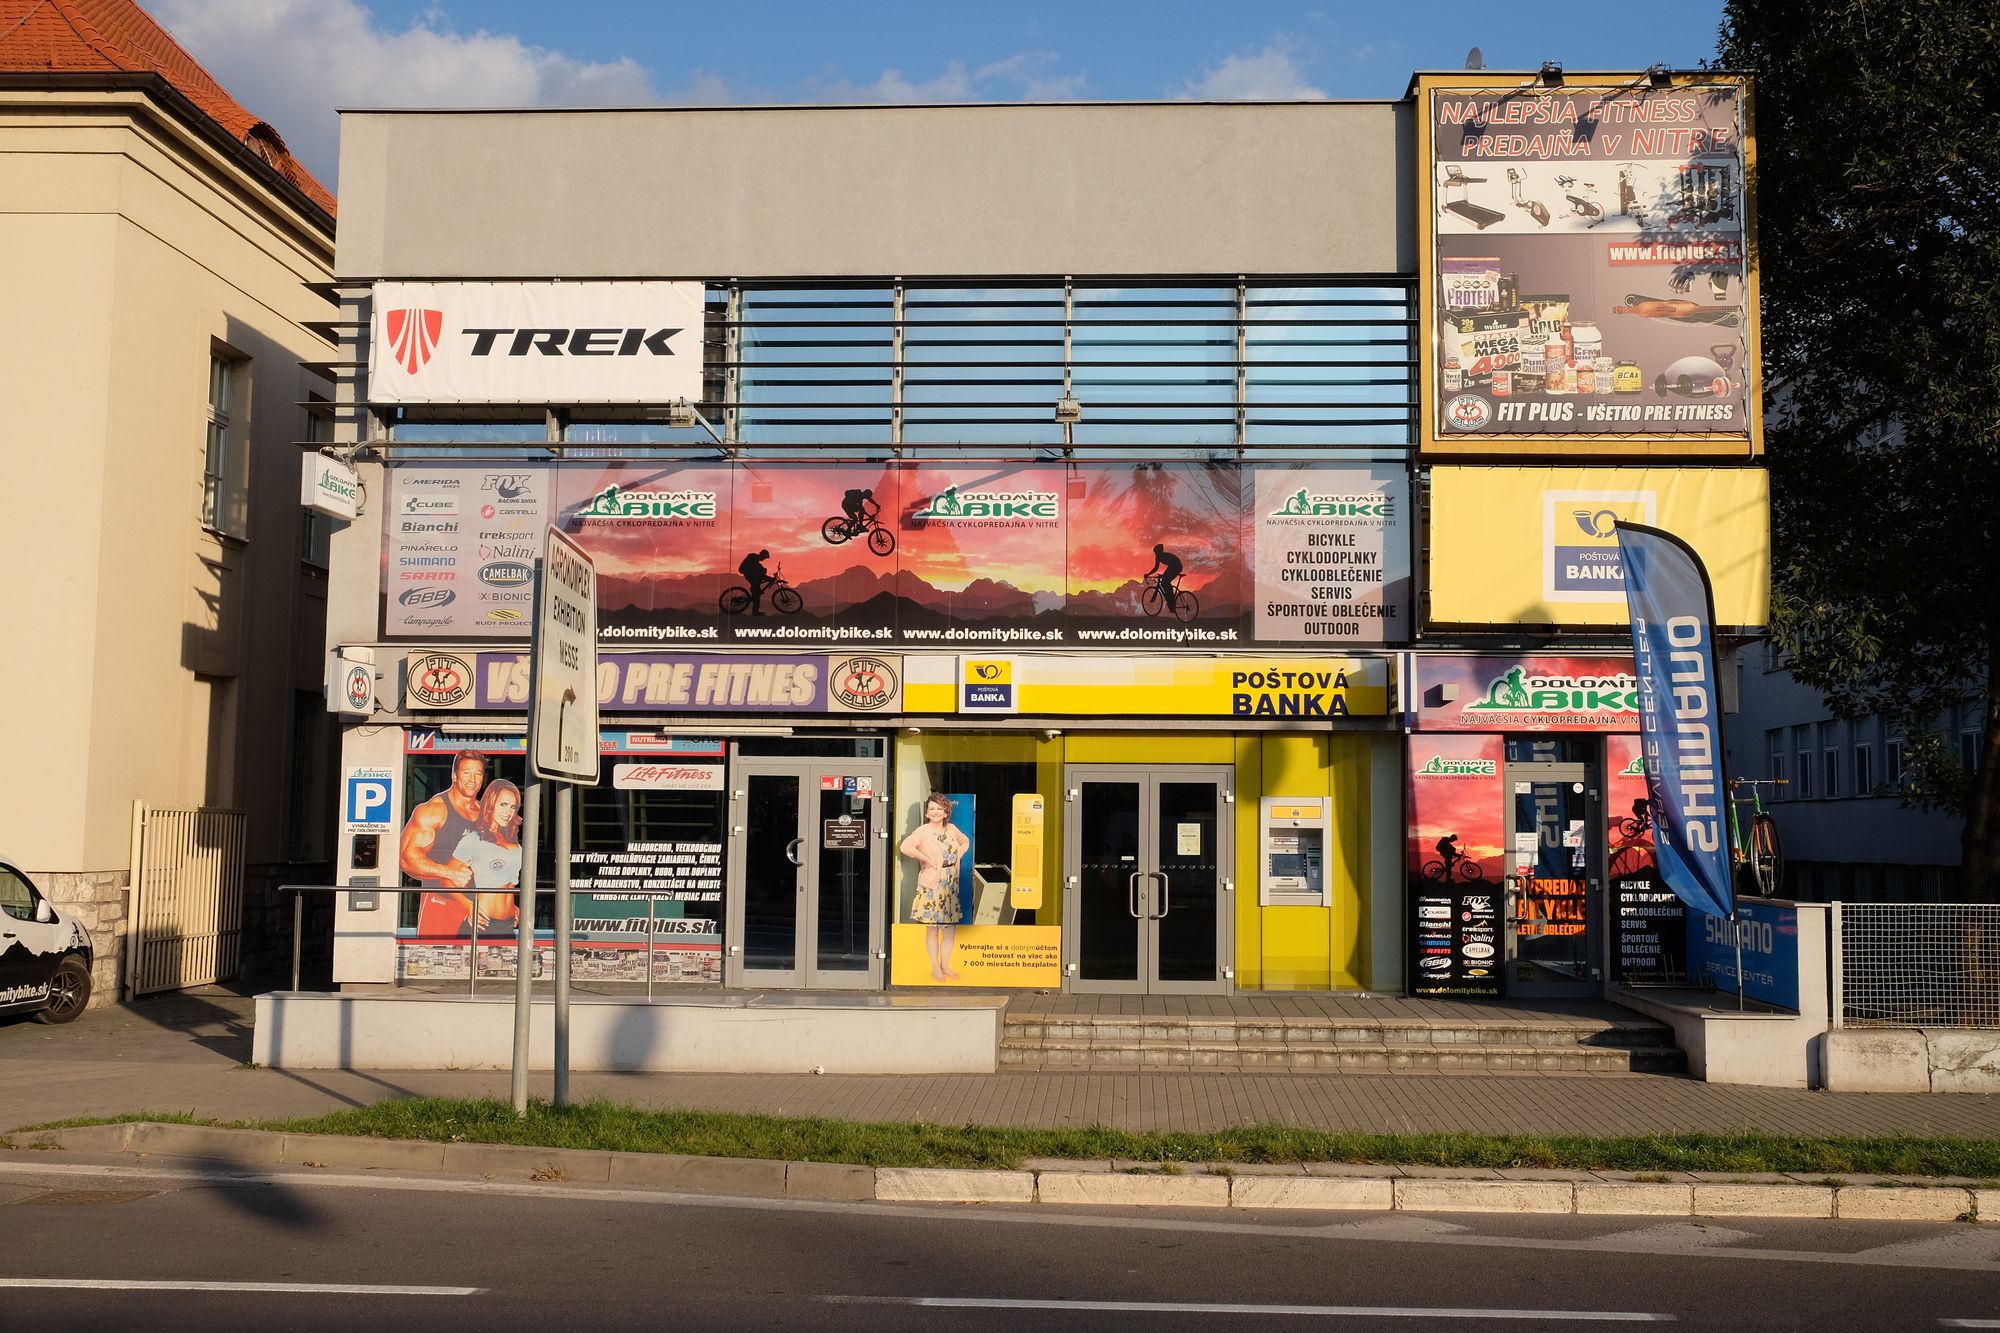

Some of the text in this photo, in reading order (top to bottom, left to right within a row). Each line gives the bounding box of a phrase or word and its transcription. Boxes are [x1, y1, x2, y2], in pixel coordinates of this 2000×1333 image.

[1441, 96, 1696, 127] NAJLEPŠIA FITNESS
[1462, 128, 1729, 159] PREDAJŇA V NITRE
[1609, 243, 1740, 262] www.fitplus.sk
[1448, 288, 1495, 306] PROTEIN
[461, 328, 685, 356] TREK
[1474, 331, 1519, 341] GIANT
[1475, 337, 1519, 349] MEGA
[1474, 345, 1519, 357] MASS
[1617, 371, 1639, 379] BCAA
[1497, 402, 1733, 421] FIT PLUS VŠETKO PRE FITNESS
[329, 481, 356, 500] BIKE
[480, 474, 532, 494] FOX
[622, 502, 714, 516] BIKE
[963, 502, 1056, 516] BIKE
[1313, 503, 1395, 516] BIKE
[401, 522, 459, 532] Bianchi
[480, 531, 535, 541] treksport
[1308, 533, 1355, 547] BICYKLE
[493, 545, 536, 560] Nalini
[1287, 551, 1377, 564] CYKLODOPLNKY
[1579, 550, 1619, 561] POŠTOVÁ
[400, 557, 456, 566] SHIMANO
[400, 572, 456, 580] SRAM
[482, 568, 530, 581] CAMELBAK
[550, 543, 591, 601] AGROKOMPLEX
[1281, 567, 1382, 582] CYKLOOBLEČENIE
[407, 589, 449, 605] BBB
[1311, 586, 1353, 600] SERVIS
[553, 595, 586, 636] EXHIBITION
[1267, 601, 1397, 618] ŠPORTOVÉ OBLEČENIE
[735, 626, 893, 640] www.dolomitybike.sk
[903, 627, 1063, 641] www.dolomitybike.sk
[1078, 627, 1238, 642] www.dolomitybike.sk
[1304, 622, 1360, 635] OUTDOOR
[559, 639, 579, 671] MESSE
[426, 656, 458, 670] FIT
[850, 661, 880, 674] FIT
[486, 655, 817, 706] VŠO PRE FITNES
[1232, 668, 1349, 689] POŠTOVÁ
[417, 686, 466, 703] PLUS
[840, 690, 888, 706] PLUS
[970, 693, 1005, 702] BANKA
[1232, 693, 1349, 716] BANKA
[1523, 714, 1616, 724] CYKLOPREDAJŇA
[1621, 715, 1628, 724] V
[564, 745, 573, 763] 200
[1443, 766, 1495, 774] BIKE
[355, 782, 387, 820] P
[586, 852, 609, 864] VÝŽIVY,
[598, 866, 621, 876] FITNES
[691, 867, 721, 877] DOPLNKY
[593, 879, 641, 889] PORADENSTVO,
[686, 880, 696, 888] NA
[696, 880, 721, 889] MIESTE
[1620, 881, 1650, 890] BICYKLE
[675, 892, 721, 901] MESIAC AKCIE
[1462, 895, 1491, 907] FOX
[1620, 905, 1684, 917] CYKLOOBLEČENIE
[574, 918, 716, 935] www.fitplus.sk
[1621, 919, 1647, 929] SERVIS
[1470, 934, 1494, 943] Nalini
[1621, 931, 1660, 943] ŠPORTOVÉ
[1621, 943, 1661, 954] OBLEČENIE
[1022, 961, 1058, 969] bezplatne
[1621, 957, 1656, 966] OUTDOOR
[1706, 961, 1736, 981] SERVICE
[1416, 987, 1498, 995] www.dolomitybike.sk
